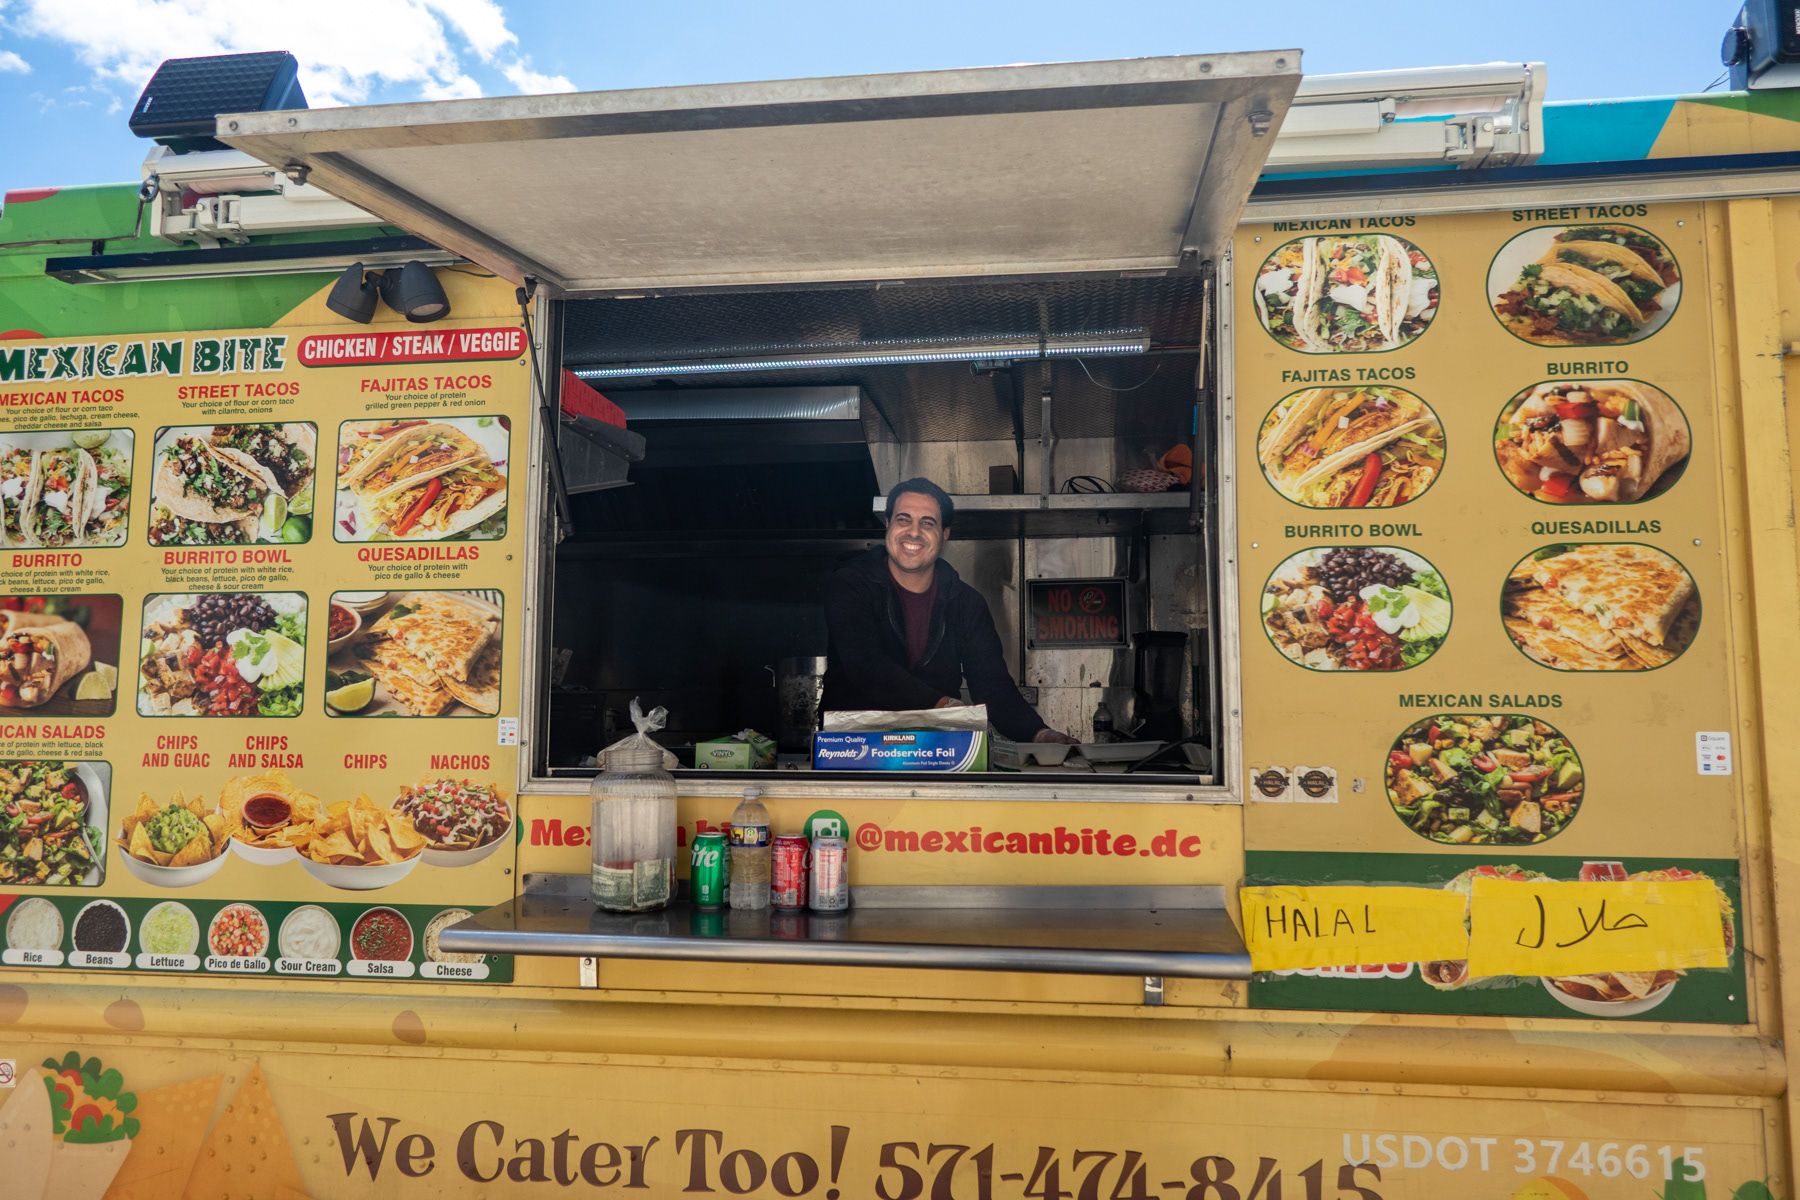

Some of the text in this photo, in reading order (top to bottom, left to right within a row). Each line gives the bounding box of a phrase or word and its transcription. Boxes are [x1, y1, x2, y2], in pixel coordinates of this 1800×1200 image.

[1512, 203, 1647, 222] STREET TACOS
[1273, 215, 1416, 232] MEXICAN TACOS
[304, 332, 521, 359] CHICKEN STEAK VEGGIE
[0, 335, 289, 384] MEXICAN BITE
[1282, 367, 1416, 383] FAJITAS TACOS
[1547, 360, 1629, 375] BURRITO
[178, 382, 299, 400] STREET TACOS
[361, 375, 492, 392] FAJITAS TACOS
[0, 389, 124, 406] MEXICAN TACOS
[430, 392, 438, 400] of
[439, 391, 466, 400] protein
[365, 402, 389, 411] grilled
[390, 402, 412, 410] green
[413, 401, 440, 409] pepper
[450, 399, 463, 407] red
[12, 416, 28, 424] pico
[1285, 524, 1423, 538] BURRITO BOWL
[1531, 520, 1662, 535] QUESADILLAS
[12, 553, 82, 568] BURRITO
[164, 549, 292, 565] BURRITO BOWL
[358, 546, 479, 562] QUESADILLAS
[32, 570, 58, 578] protein
[178, 567, 202, 575] choice
[213, 567, 238, 575] protein
[368, 564, 385, 572] Your
[413, 563, 422, 571] of
[423, 563, 450, 572] protein
[58, 577, 74, 586] pico
[240, 575, 256, 583] pico
[374, 572, 391, 581] pico
[404, 572, 423, 581] gallo
[188, 583, 214, 591] cheese
[1048, 589, 1071, 613] NO
[1037, 615, 1119, 640] SMOKING
[1399, 694, 1563, 708] MEXICAN SALADS
[0, 725, 105, 739] ICAN SALADS
[15, 741, 40, 749] protein
[157, 735, 198, 750] CHIPS
[246, 736, 288, 751] CHIPS
[845, 736, 867, 744] Quality
[84, 749, 103, 757] salsa
[142, 753, 210, 768] AND GUAC
[228, 753, 303, 768] AND SALSA
[818, 747, 955, 760] Reynolds Foodservice Foil
[344, 754, 387, 769] CHIPS
[431, 755, 490, 770] NACHOS
[855, 822, 1202, 858] @mexicanbite.dc
[1266, 904, 1376, 941] HALAL
[1516, 895, 1648, 948] حلال
[23, 952, 43, 963] Rice
[86, 954, 114, 965] Beans
[150, 956, 185, 968] Lettuce
[209, 958, 266, 970] Pico de Gallo
[281, 961, 336, 973] Sour Cream
[367, 963, 394, 974] Salsa
[436, 965, 472, 977] Cheese
[326, 1112, 435, 1183] We
[456, 1119, 660, 1189] Cater
[675, 1125, 851, 1200] Too!
[1342, 1133, 1706, 1183] USDOT 3746615
